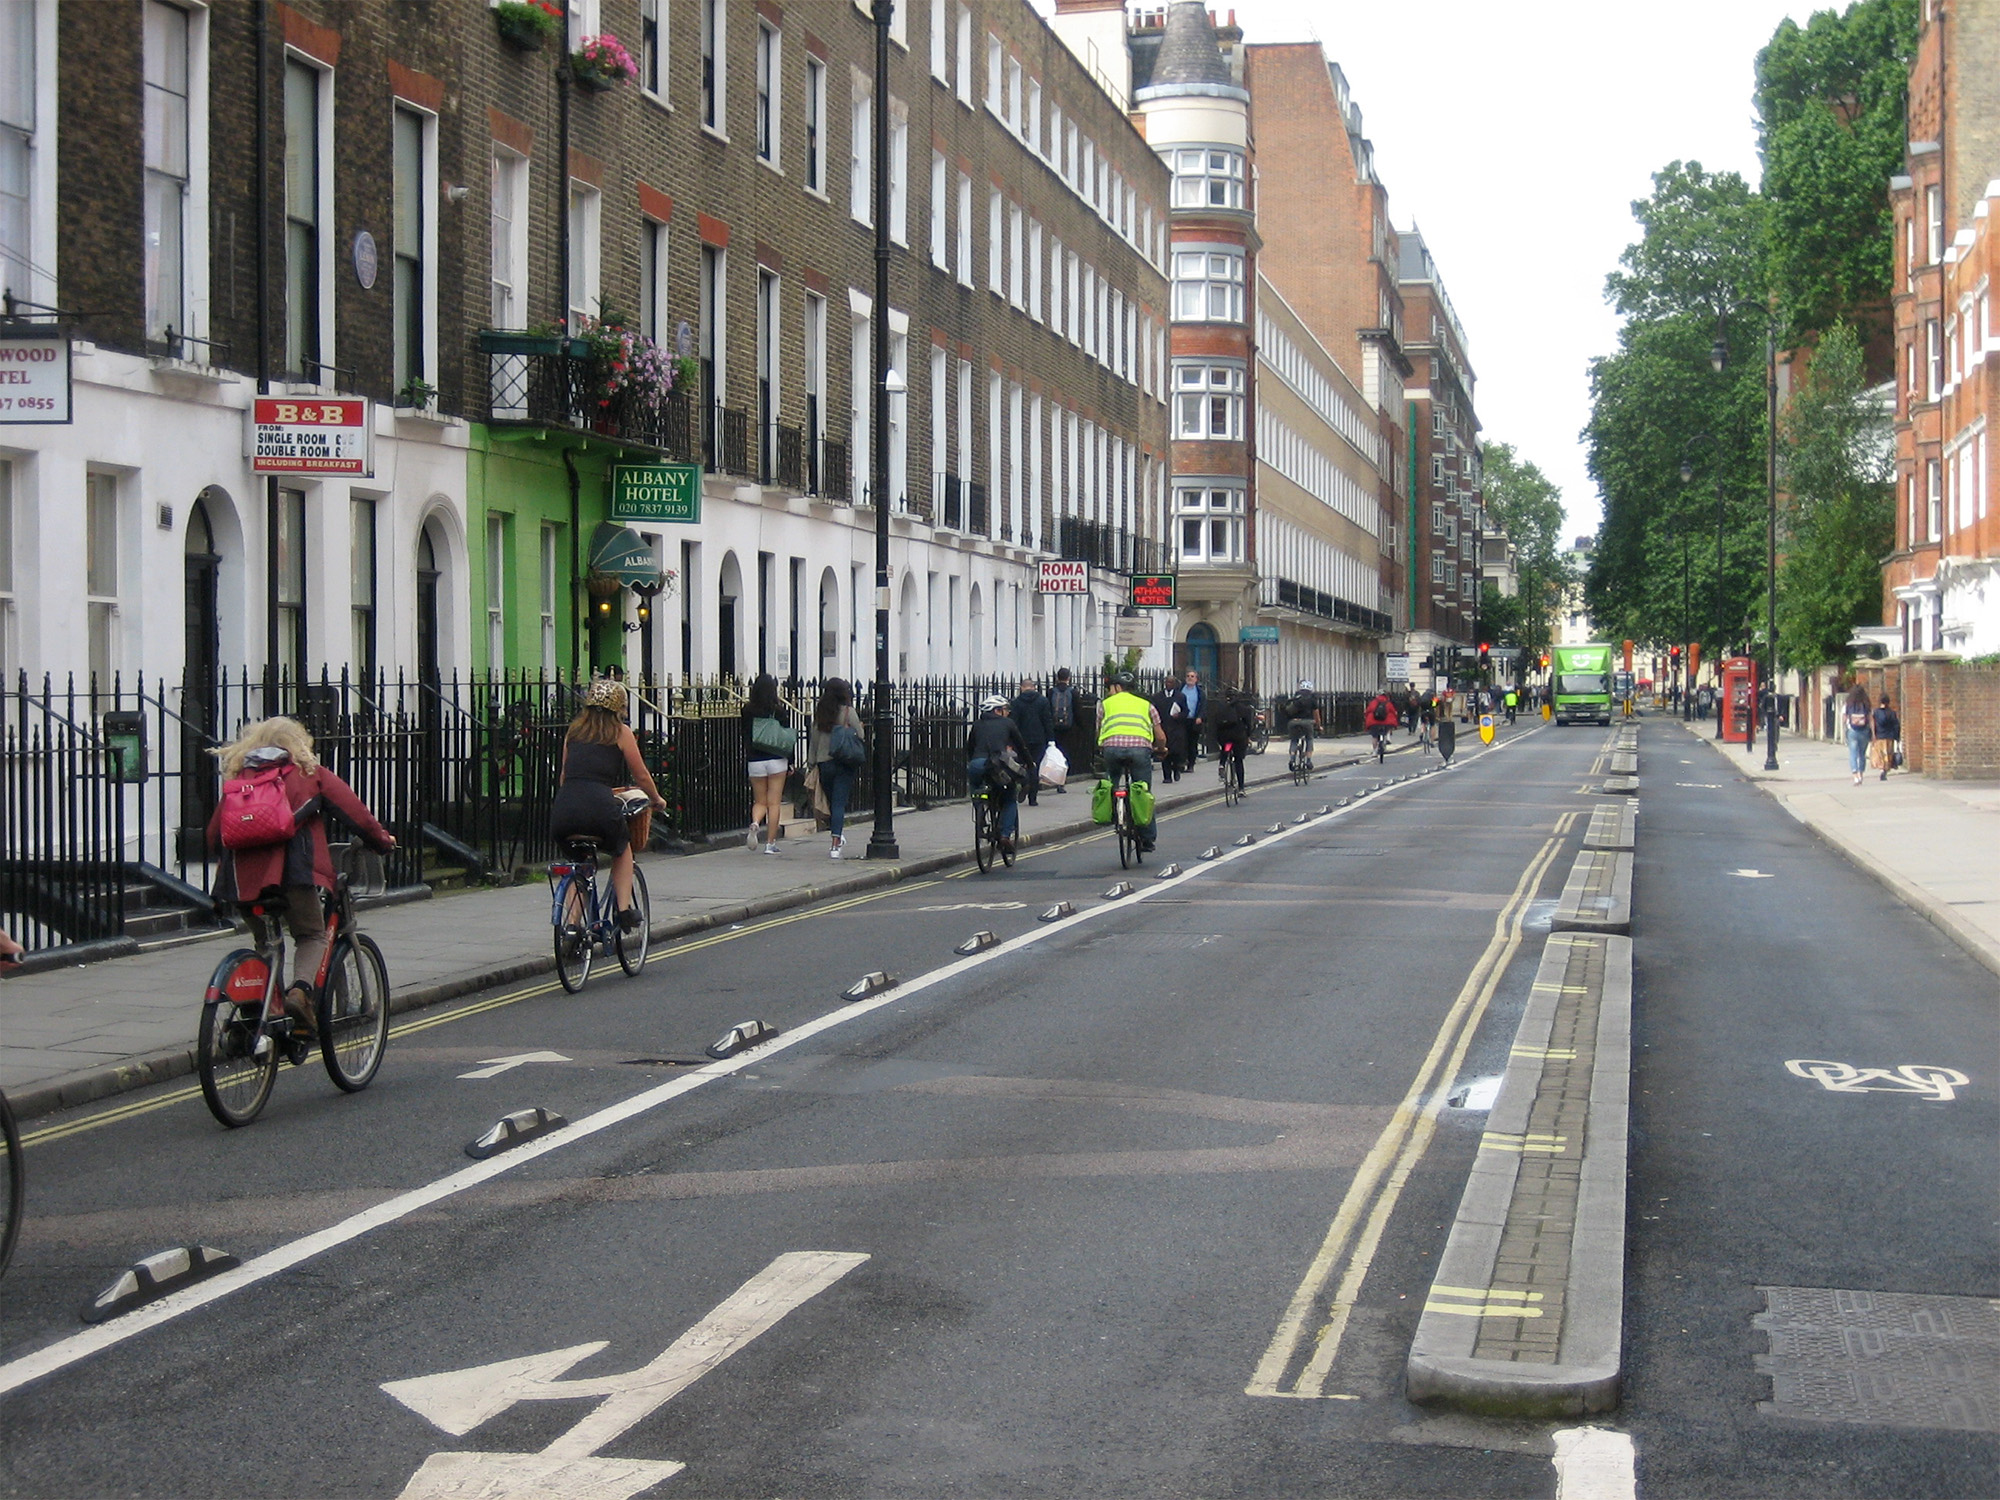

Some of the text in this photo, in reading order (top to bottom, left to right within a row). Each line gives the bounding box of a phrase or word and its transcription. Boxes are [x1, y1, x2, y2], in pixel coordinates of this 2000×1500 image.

[18, 397, 55, 410] 0855
[257, 432, 293, 444] SINGLE
[296, 433, 326, 445] ROOM
[257, 445, 296, 457] DOUBLE
[300, 446, 330, 457] ROOM
[257, 459, 358, 469] INCLUDING BREAKFAST
[621, 471, 690, 486] ALBANY
[625, 487, 683, 502] HOTEL
[618, 503, 688, 515] 020 7837 9139
[1042, 563, 1085, 576] ROMA
[1040, 579, 1086, 591] HOTEL
[1134, 586, 1172, 596] ATHANS
[1136, 596, 1170, 605] HOTEL
